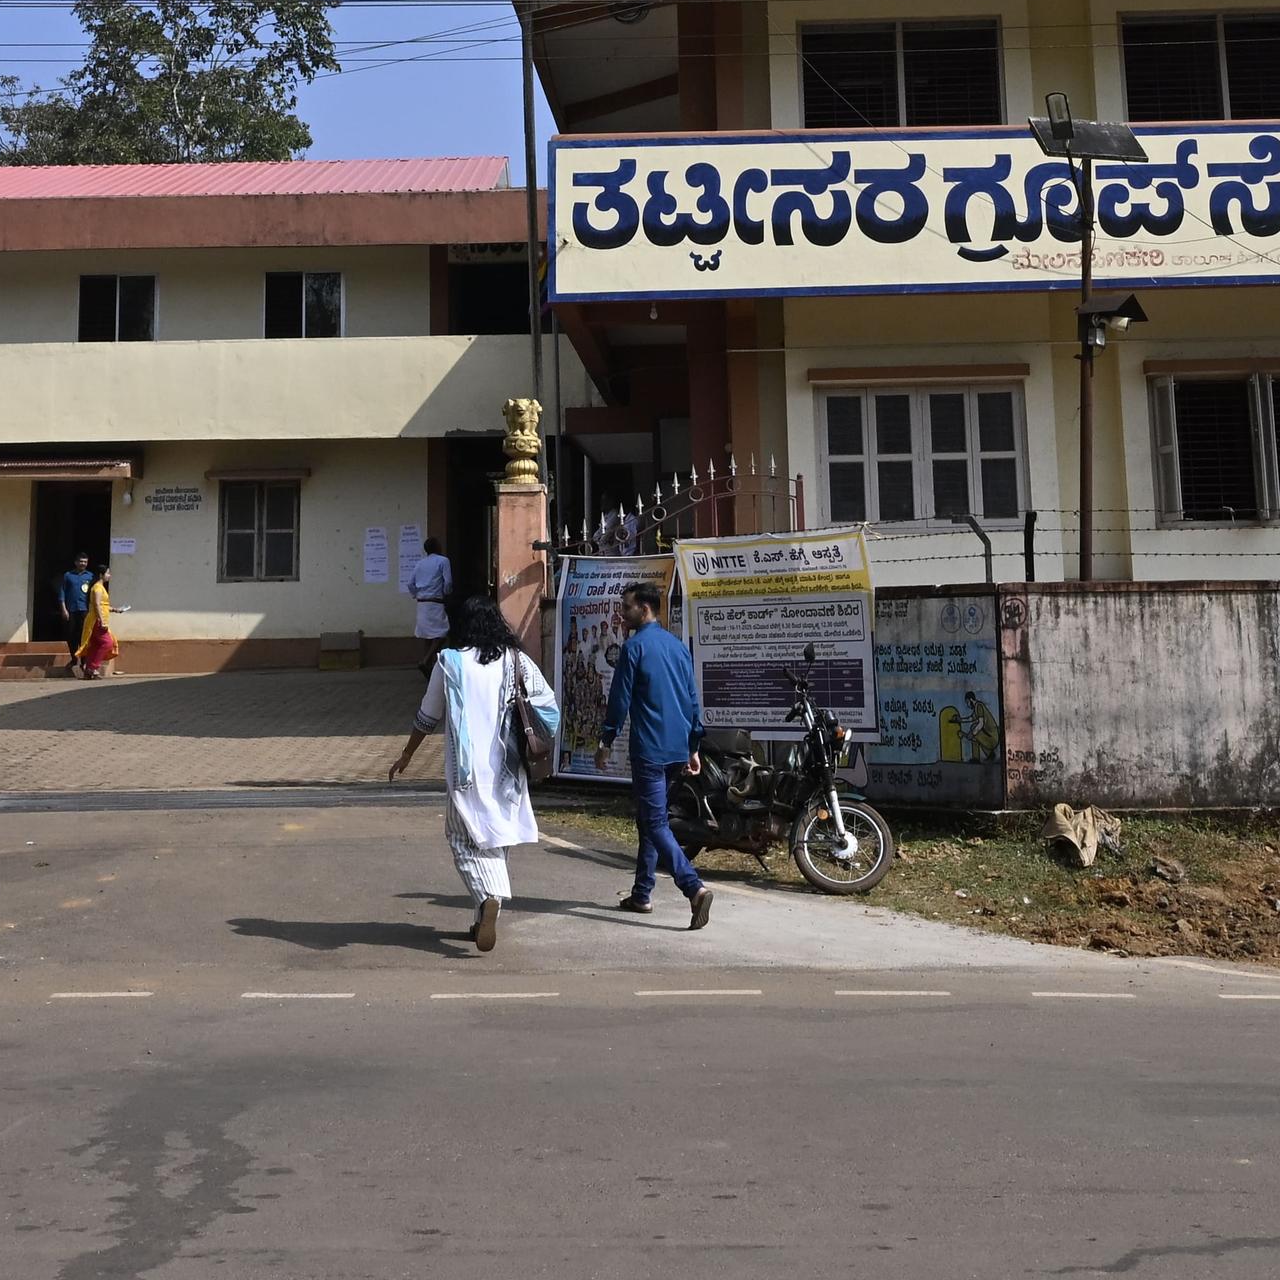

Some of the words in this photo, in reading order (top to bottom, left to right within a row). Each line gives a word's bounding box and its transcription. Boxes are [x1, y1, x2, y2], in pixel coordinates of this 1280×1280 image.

[571, 152, 929, 271] ತಟ್ಟೀಸರ
[944, 137, 1199, 261] ಗ್ರೂಪ್
[712, 555, 746, 571] NITTE
[812, 546, 844, 564] ಆಸ್ಪತ್ರೆ
[838, 604, 860, 617] ಶಿಬಿರ
